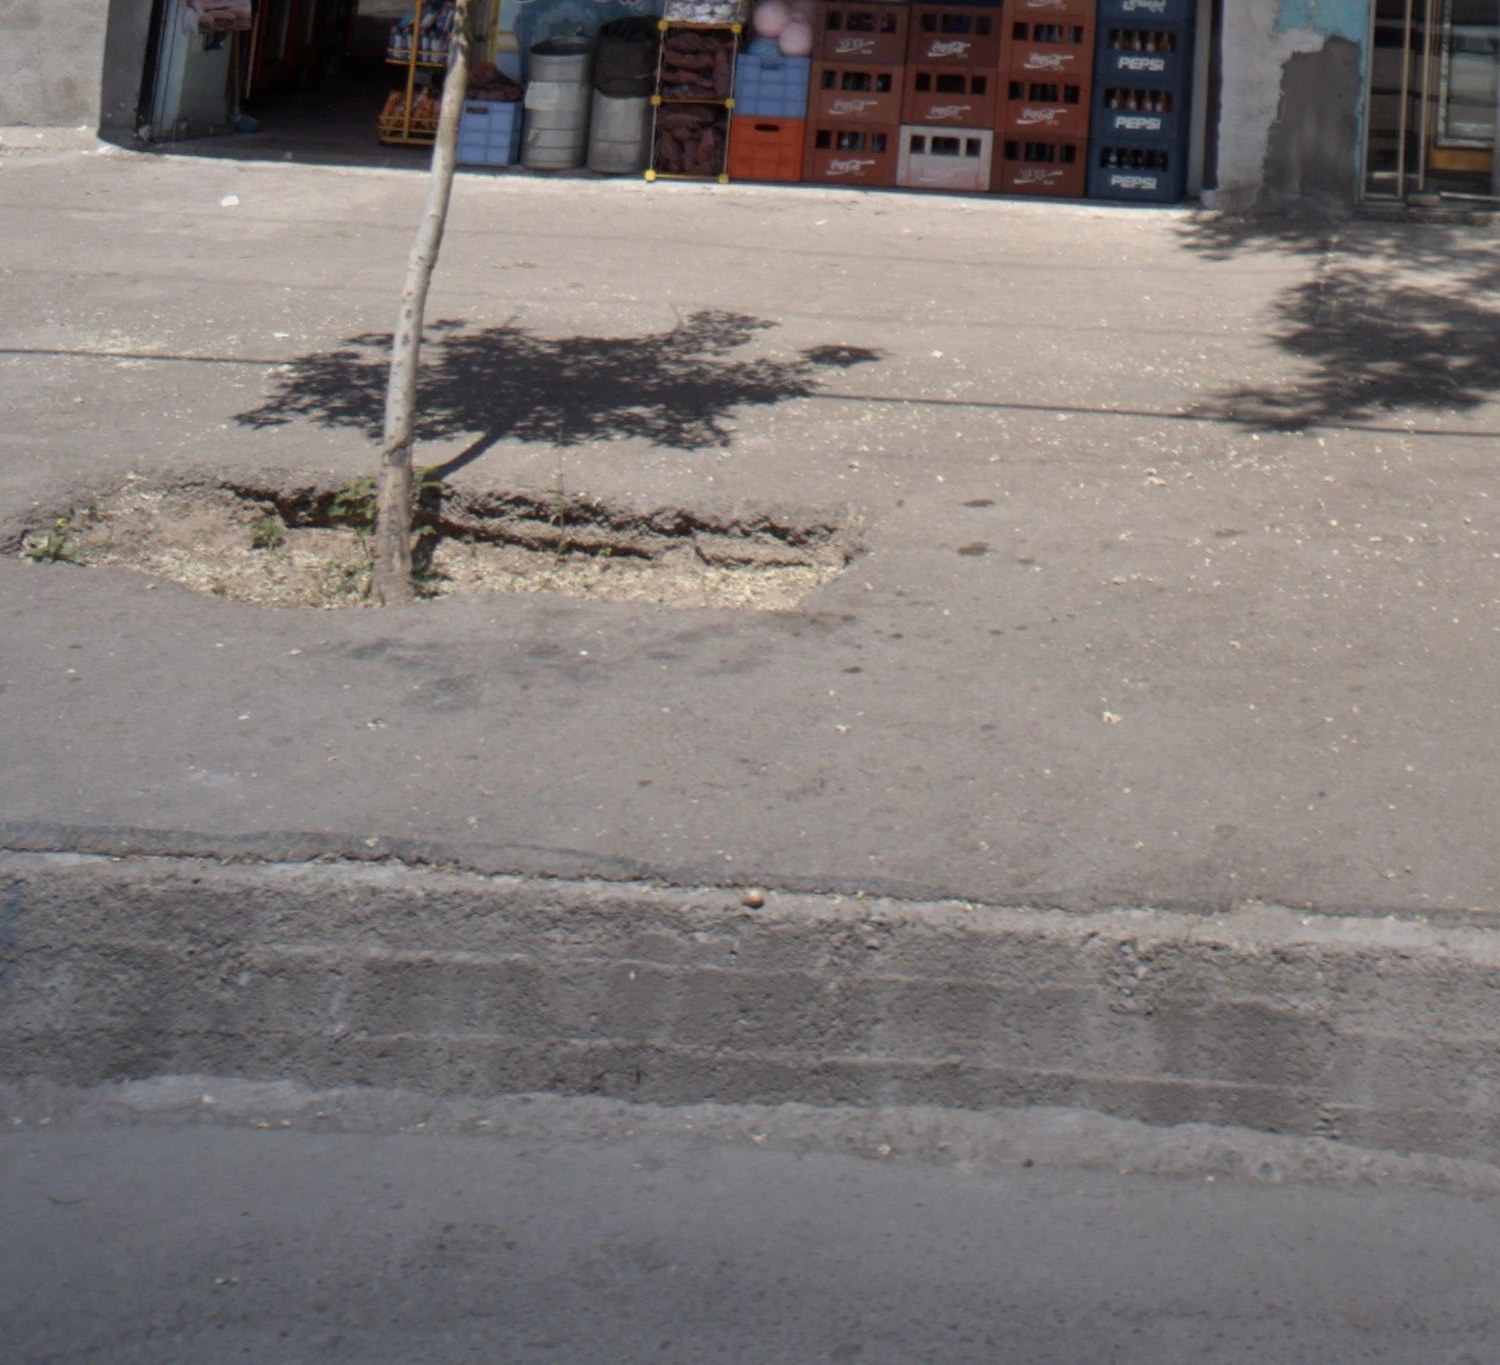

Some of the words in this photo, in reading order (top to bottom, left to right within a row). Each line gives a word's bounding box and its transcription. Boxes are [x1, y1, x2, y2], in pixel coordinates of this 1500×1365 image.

[1118, 56, 1165, 71] PEPSI
[1115, 115, 1162, 131] PEPSI
[1110, 174, 1157, 190] PEPSI
